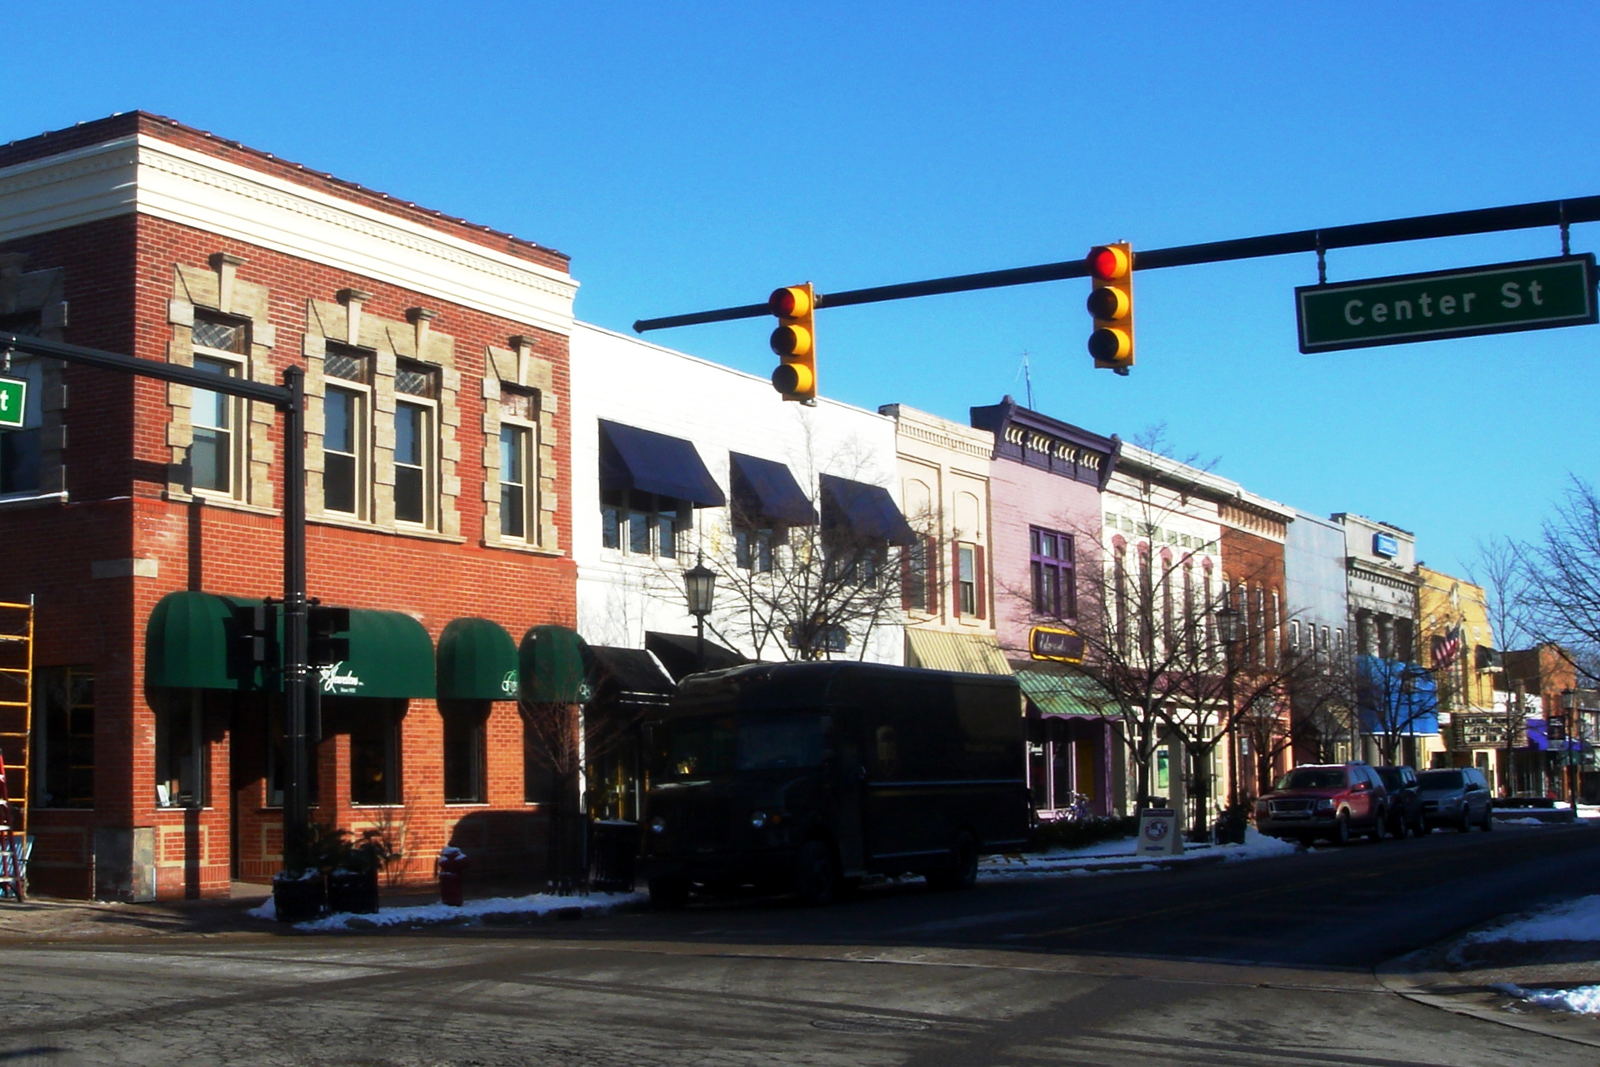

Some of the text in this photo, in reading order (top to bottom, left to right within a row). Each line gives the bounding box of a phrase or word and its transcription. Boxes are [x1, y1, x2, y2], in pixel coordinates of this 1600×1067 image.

[1343, 279, 1545, 326] Center St
[0, 389, 10, 412] t
